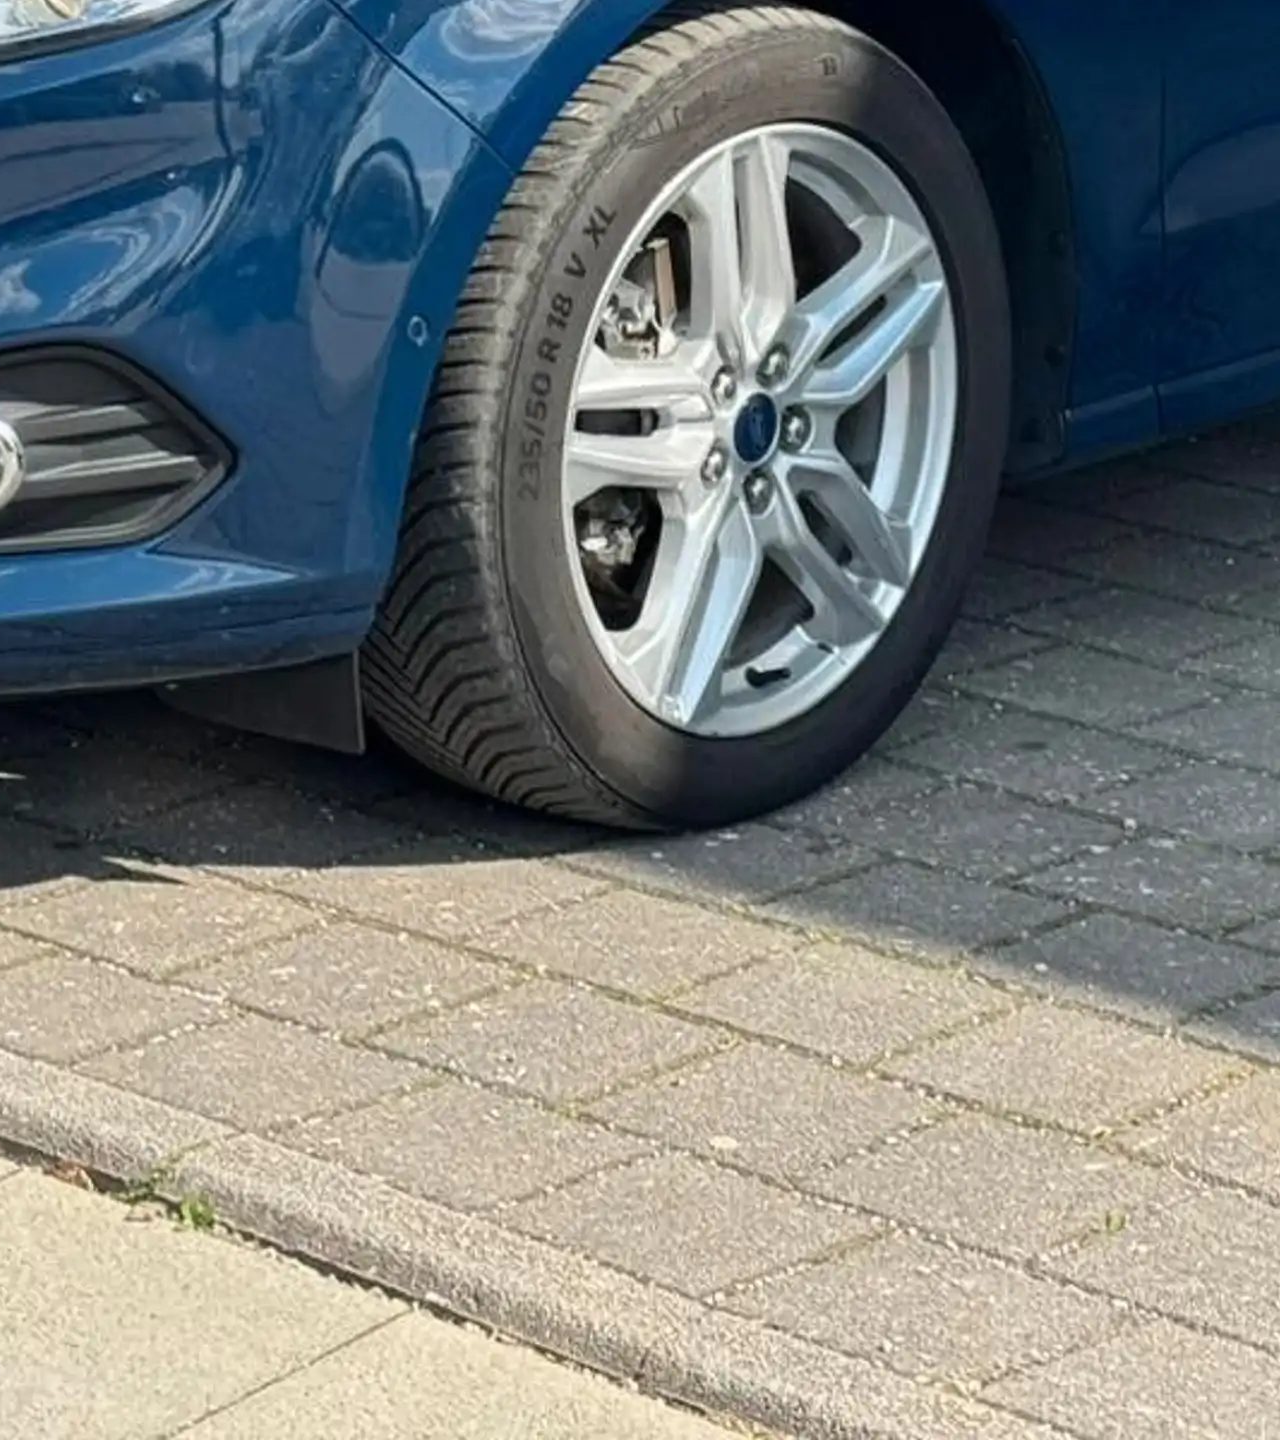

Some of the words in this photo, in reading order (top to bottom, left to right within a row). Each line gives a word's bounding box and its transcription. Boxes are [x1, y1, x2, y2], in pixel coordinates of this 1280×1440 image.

[581, 205, 618, 251] XL
[562, 250, 587, 279] V
[546, 292, 574, 331] 18
[536, 336, 563, 364] R
[517, 370, 552, 502] 235/50
